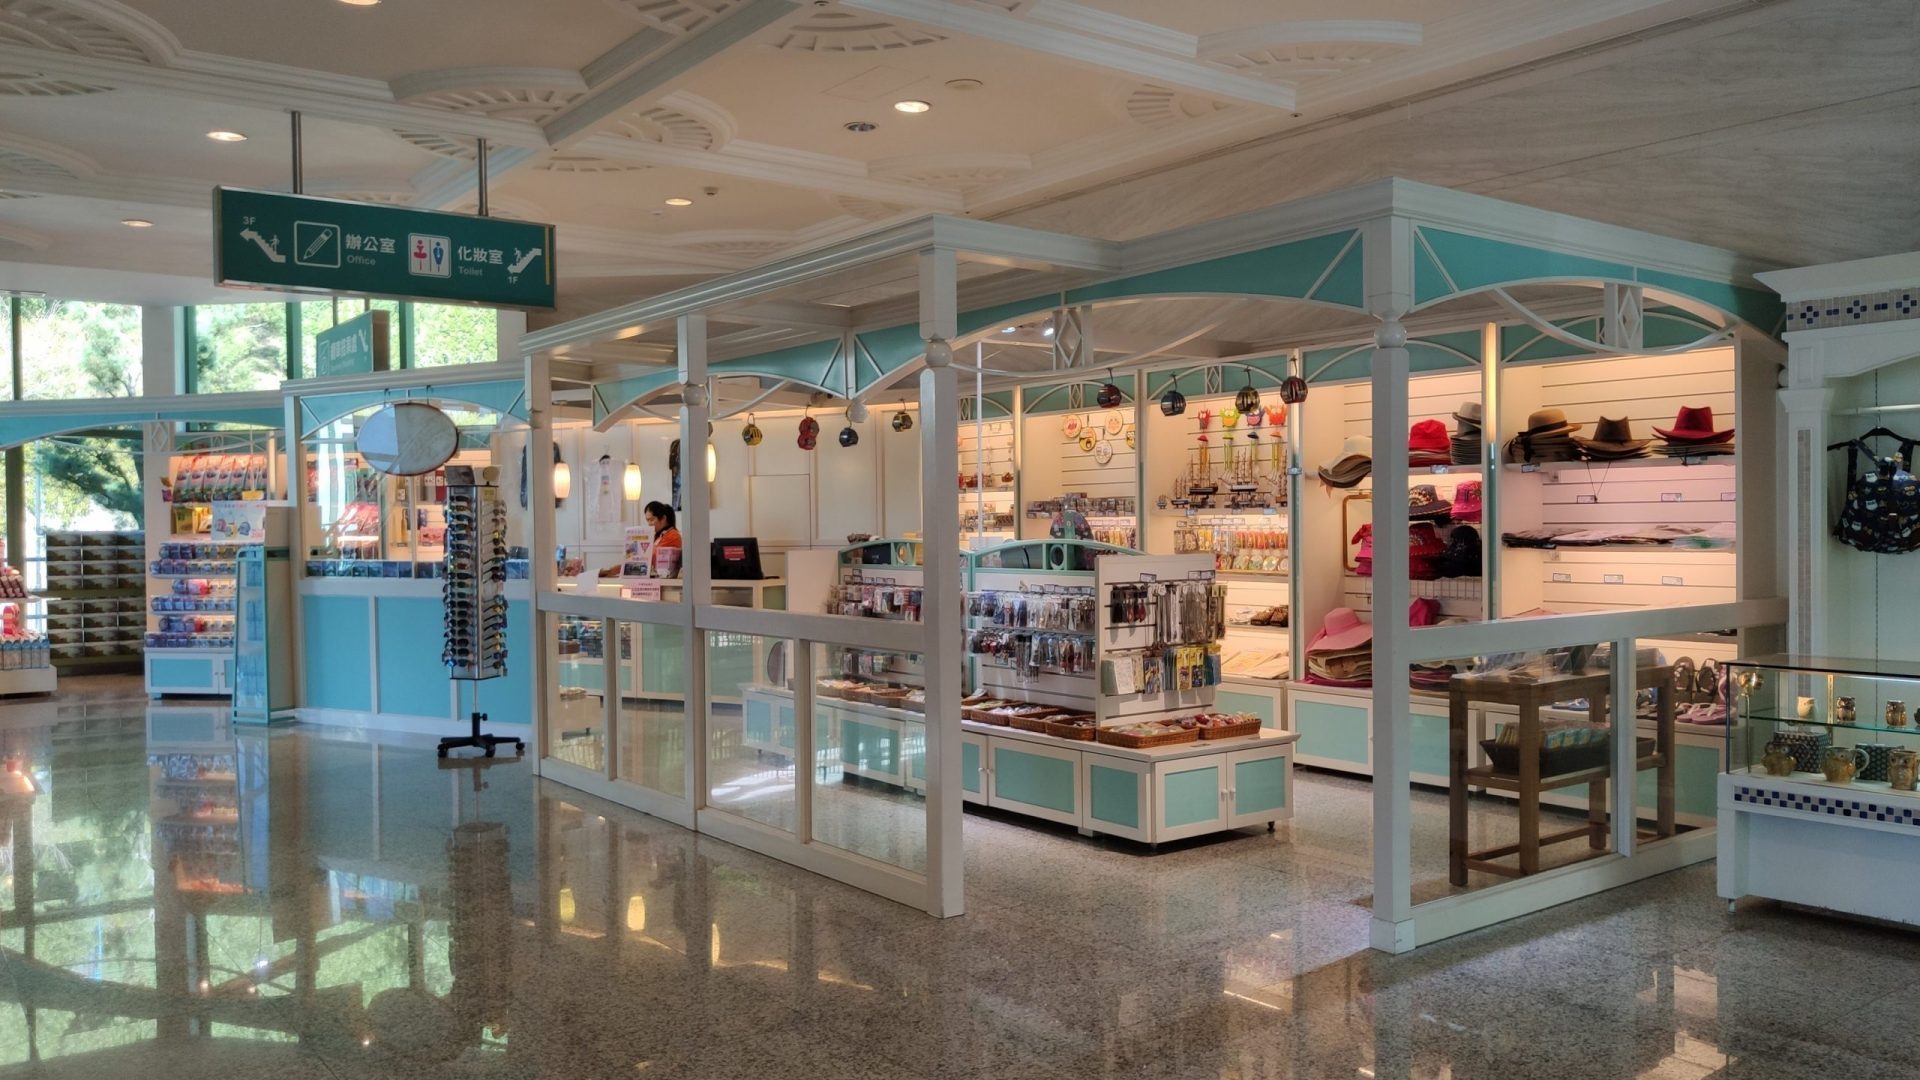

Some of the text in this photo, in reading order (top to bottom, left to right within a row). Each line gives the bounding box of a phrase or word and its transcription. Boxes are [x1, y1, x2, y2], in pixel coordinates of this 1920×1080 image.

[242, 216, 256, 225] 3F
[346, 255, 376, 266] Office
[458, 246, 504, 265] 化妝室
[458, 266, 483, 276] Toilet
[508, 276, 519, 285] 1F
